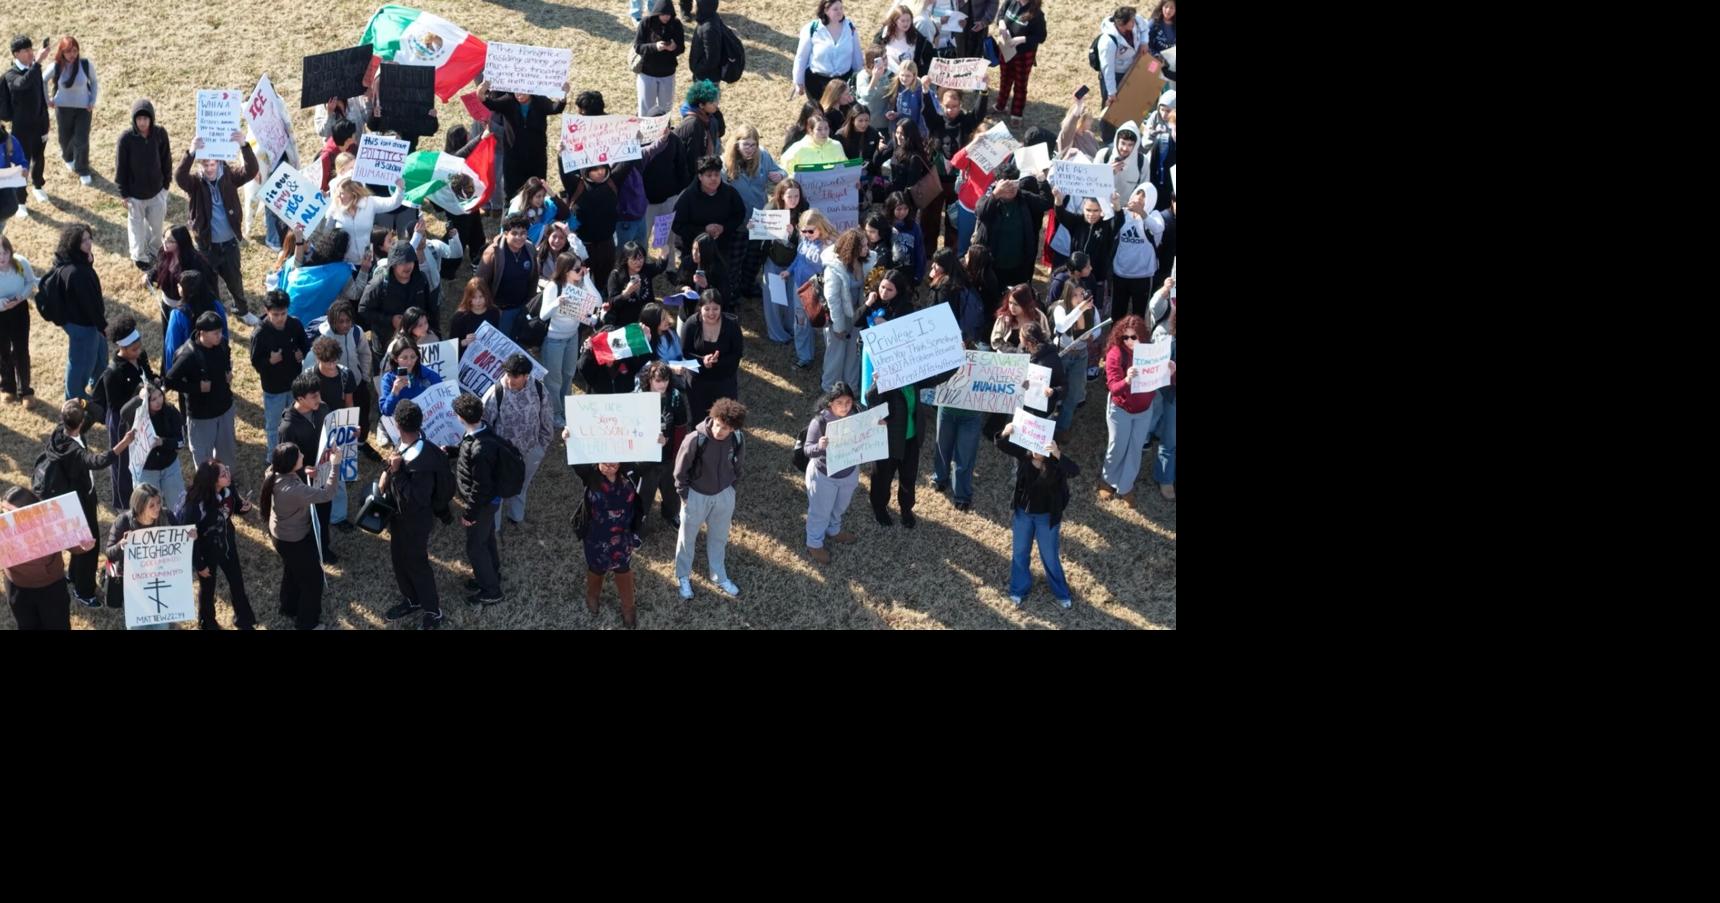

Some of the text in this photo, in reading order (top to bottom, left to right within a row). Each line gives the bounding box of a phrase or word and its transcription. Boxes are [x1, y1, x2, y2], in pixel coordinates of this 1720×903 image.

[249, 89, 267, 120] ICE
[286, 180, 299, 192] &
[300, 203, 320, 224] ALL
[1121, 236, 1145, 244] adidas
[966, 351, 977, 364] RE
[1141, 364, 1160, 375] NOT
[972, 381, 1015, 395] HUMANS
[132, 528, 191, 545] LOVE THY
